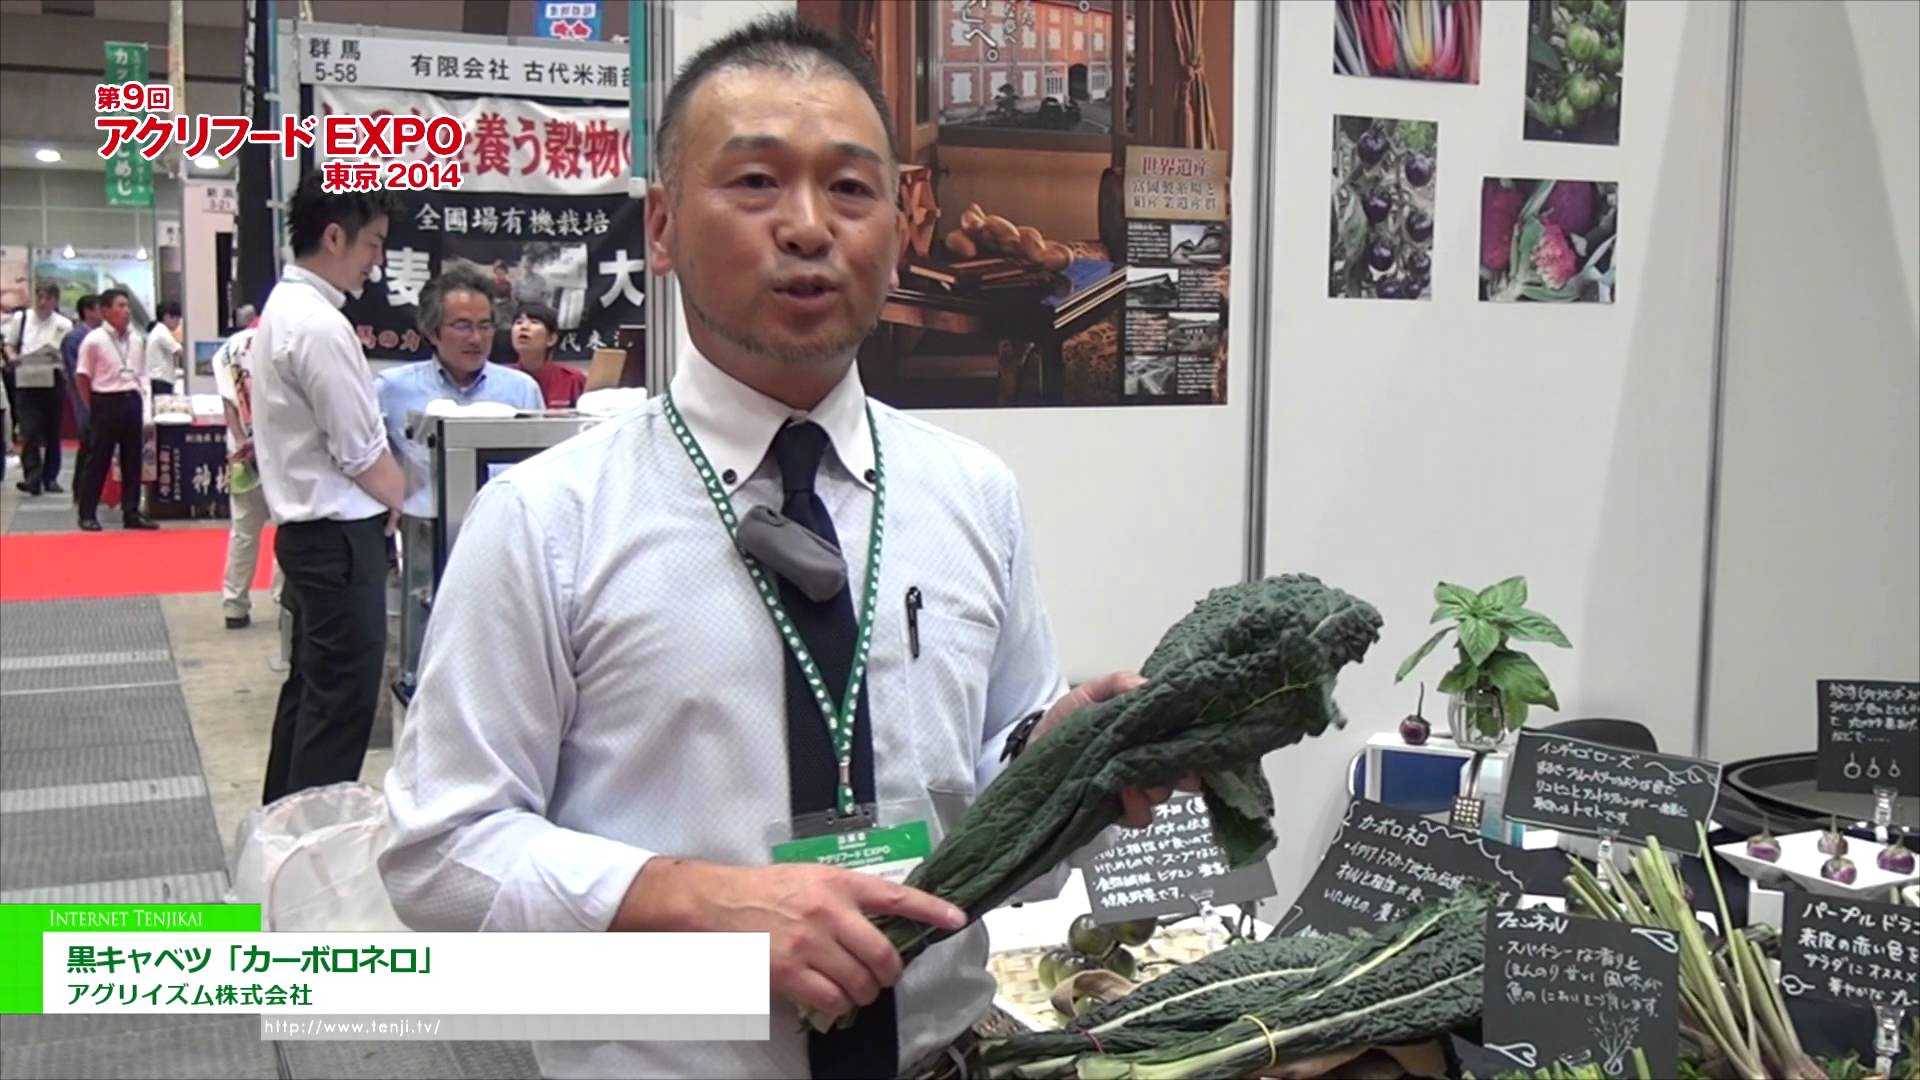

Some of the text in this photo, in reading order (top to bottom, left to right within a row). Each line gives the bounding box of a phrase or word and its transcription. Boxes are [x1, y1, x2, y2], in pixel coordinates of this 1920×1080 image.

[314, 62, 358, 83] 5-58
[411, 54, 511, 82] 有限会社
[1496, 911, 1568, 934] フェンネル
